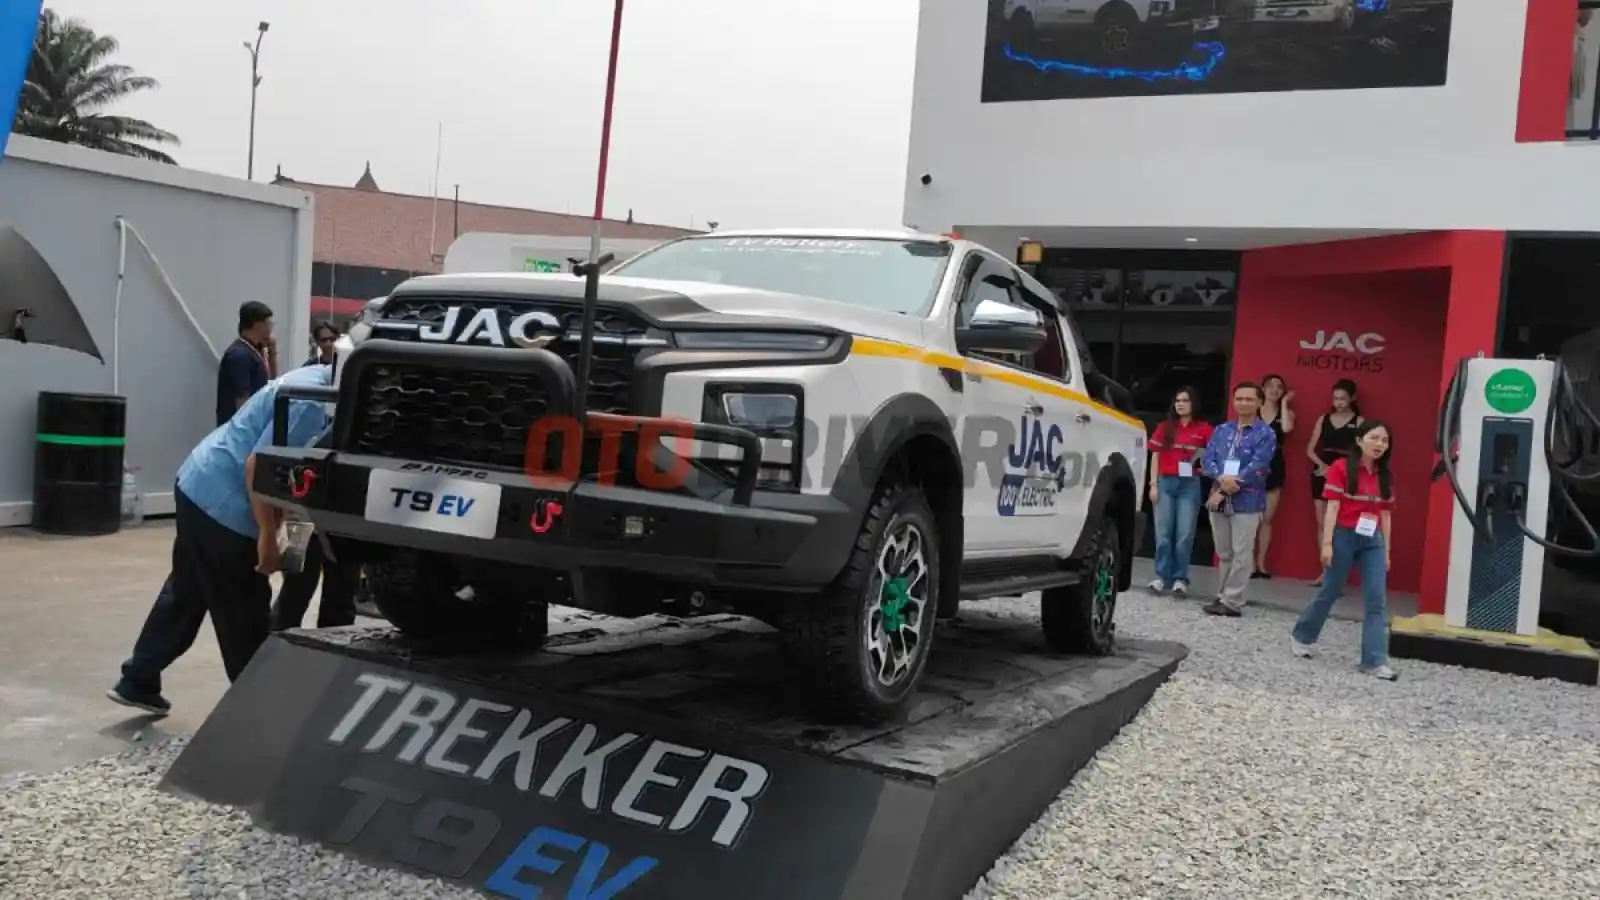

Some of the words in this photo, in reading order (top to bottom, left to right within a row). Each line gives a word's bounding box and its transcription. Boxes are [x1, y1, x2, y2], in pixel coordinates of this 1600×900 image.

[419, 305, 561, 350] JAC
[1299, 330, 1386, 354] JAC
[1296, 353, 1385, 373] MOTORS
[1008, 414, 1064, 473] JAC
[390, 486, 434, 512] T9
[436, 494, 476, 518] EV
[328, 672, 773, 850] TREKKER
[329, 775, 503, 879] T9
[483, 825, 660, 900] EV
